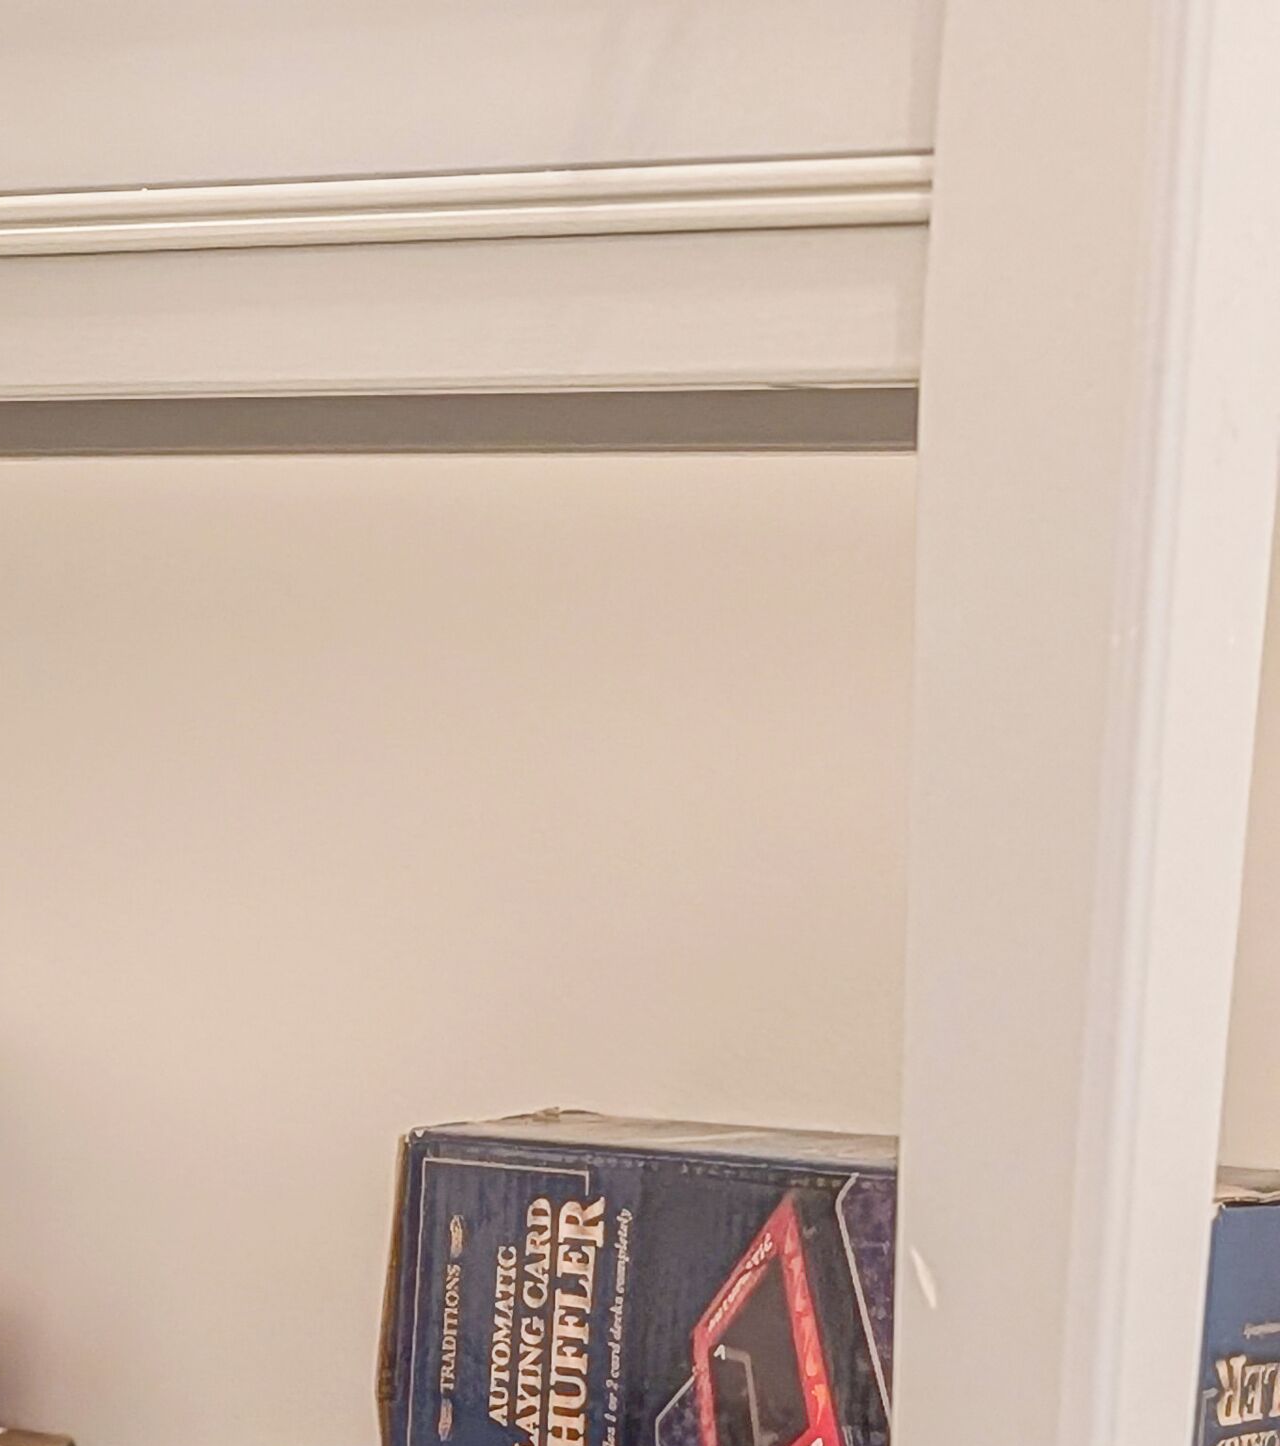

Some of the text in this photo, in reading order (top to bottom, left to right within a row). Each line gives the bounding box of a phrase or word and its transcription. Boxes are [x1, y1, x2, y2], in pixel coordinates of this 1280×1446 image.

[522, 1197, 553, 1310] CARD
[440, 1264, 462, 1392] TRADITIONS
[488, 1245, 518, 1428] AUTOMATIC
